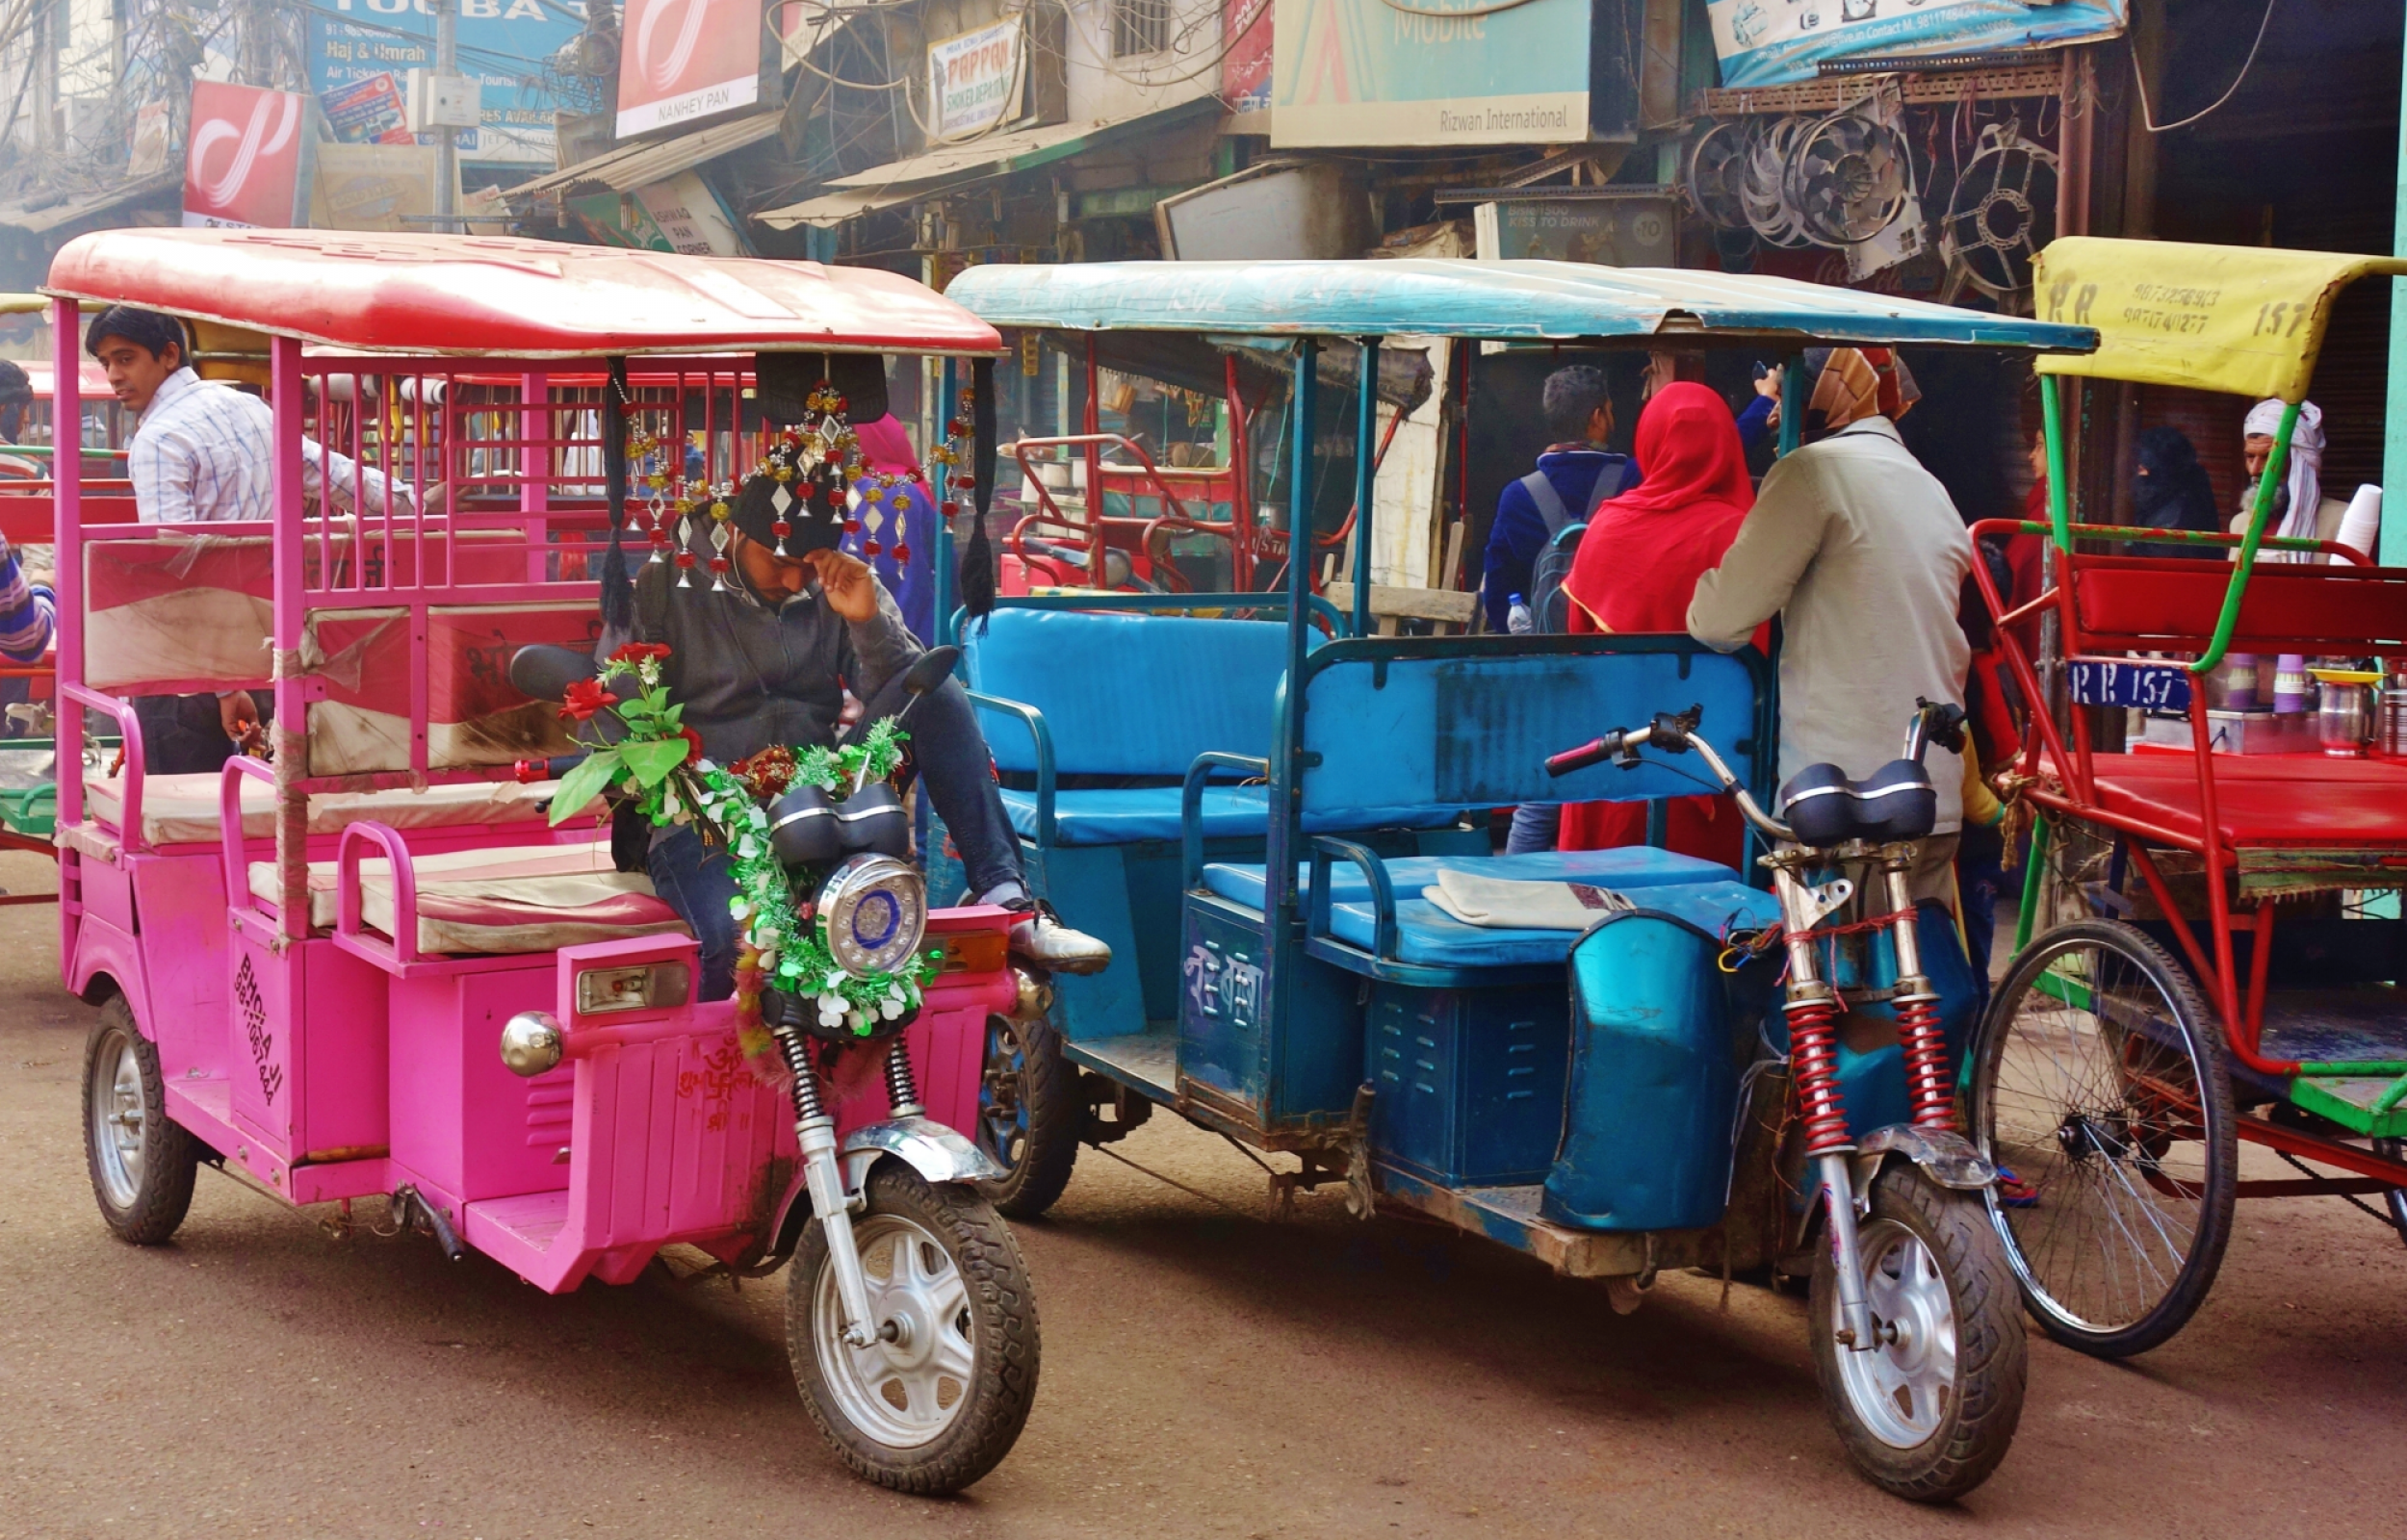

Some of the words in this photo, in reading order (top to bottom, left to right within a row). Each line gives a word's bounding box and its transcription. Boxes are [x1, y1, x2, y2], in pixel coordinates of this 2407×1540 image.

[1394, 0, 1488, 44] Mobile
[1867, 24, 1902, 39] Contact
[326, 40, 352, 62] Haj
[357, 42, 370, 59] &
[375, 44, 426, 62] Umrah
[948, 38, 1009, 90] PAPPAN
[326, 66, 343, 79] Air
[659, 96, 704, 121] NANHEY
[707, 88, 730, 109] PAN
[1440, 109, 1483, 132] Rizwan
[1486, 104, 1568, 131] International
[673, 225, 694, 239] PAN
[1509, 217, 1536, 227] KISS
[1540, 217, 1557, 227] TO
[1561, 216, 1600, 227] DRINK
[2253, 300, 2307, 337] 157
[2132, 669, 2173, 705] 157
[269, 1063, 283, 1093] JI
